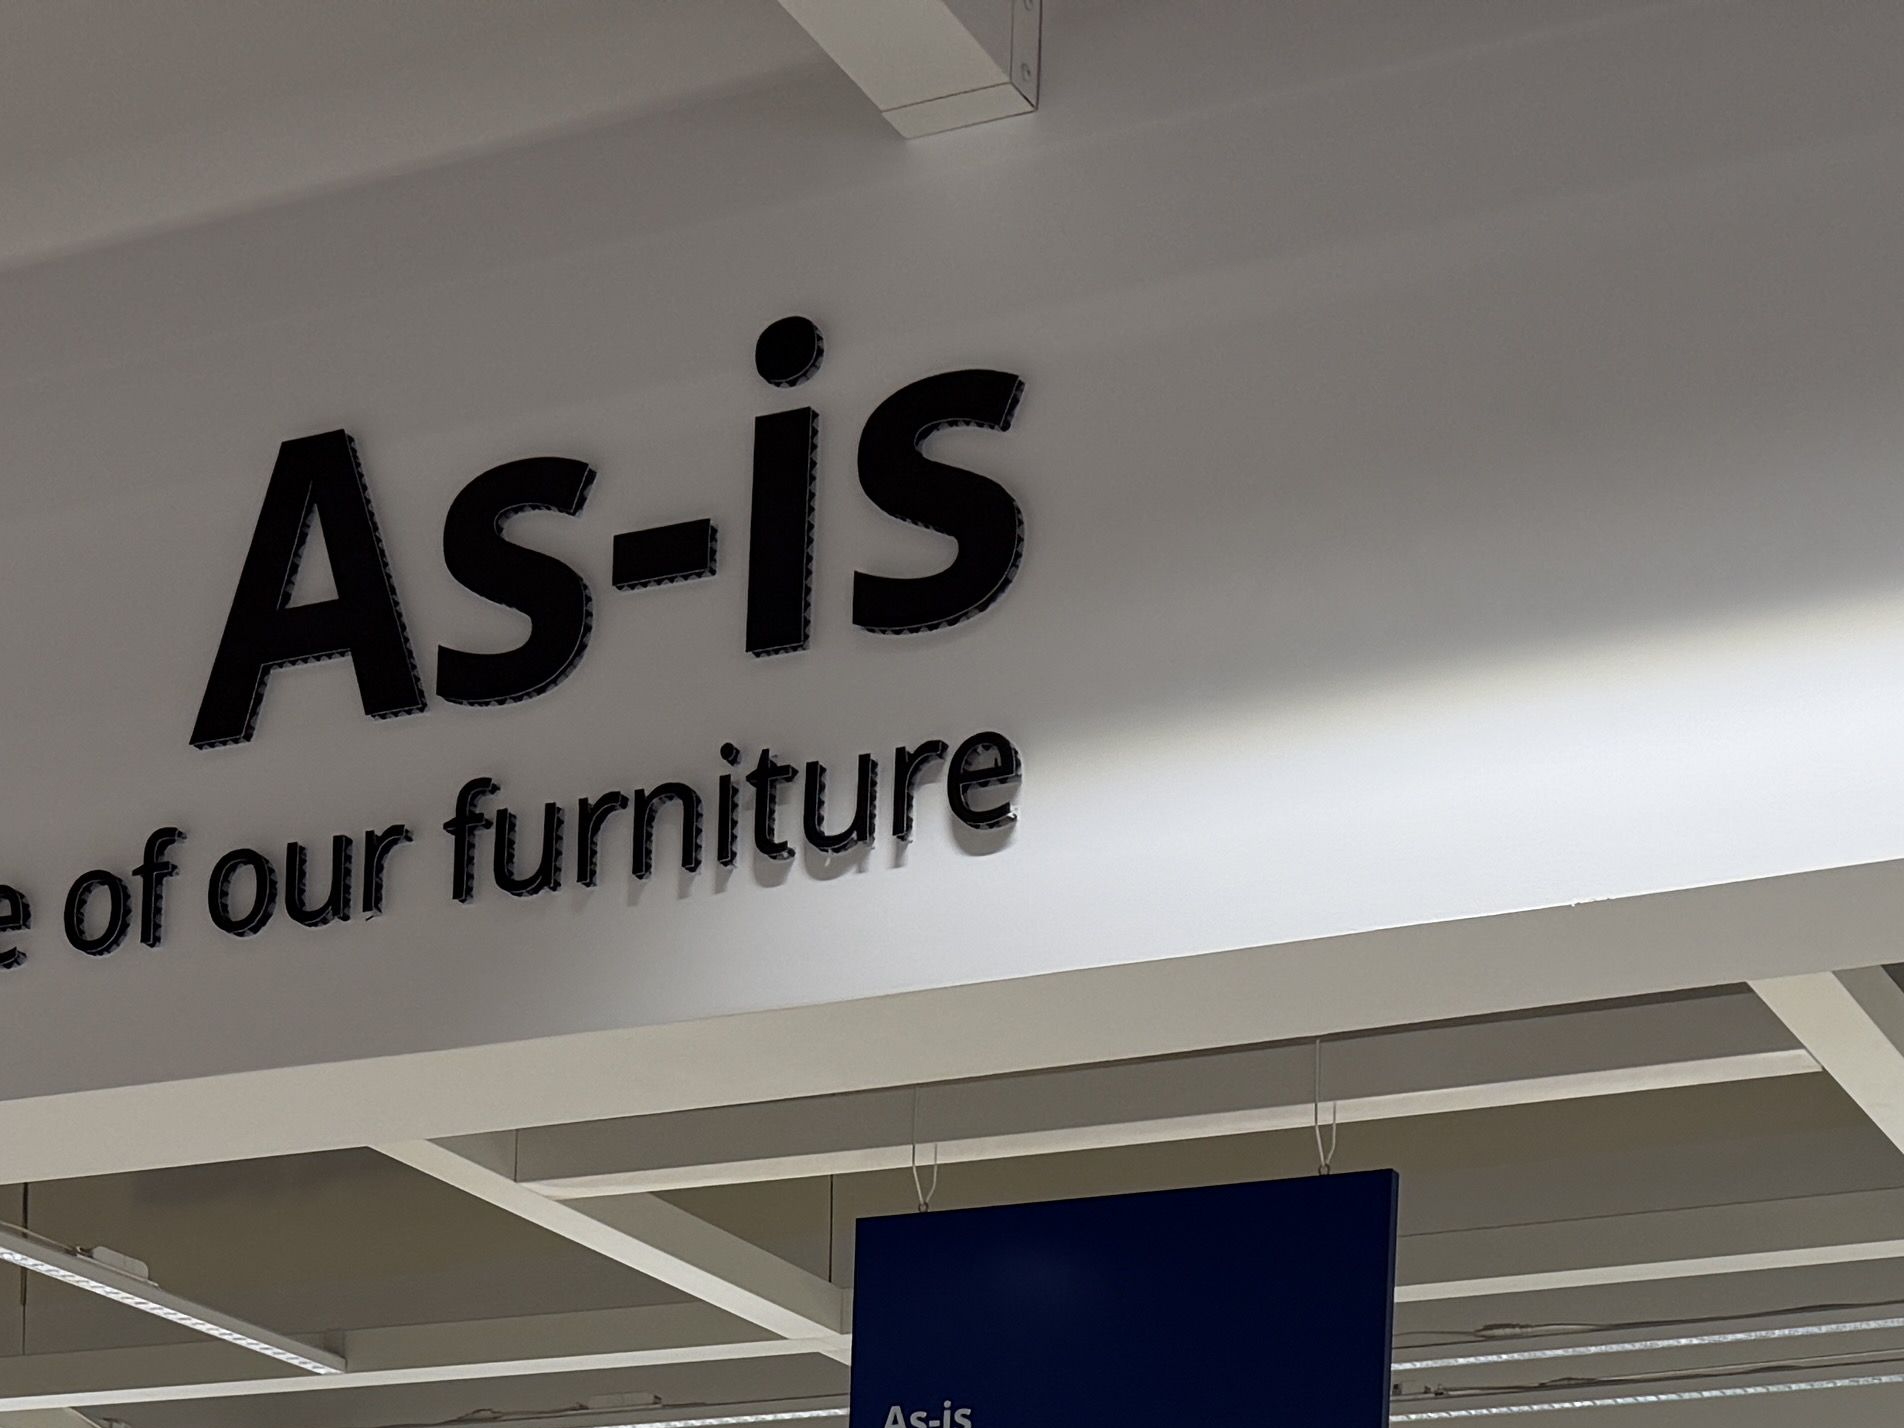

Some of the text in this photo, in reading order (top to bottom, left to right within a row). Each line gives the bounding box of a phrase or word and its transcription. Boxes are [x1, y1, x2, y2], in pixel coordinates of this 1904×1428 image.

[190, 315, 1025, 750] As-is
[63, 827, 187, 957] of
[208, 824, 414, 938] our
[445, 730, 1023, 904] furniture
